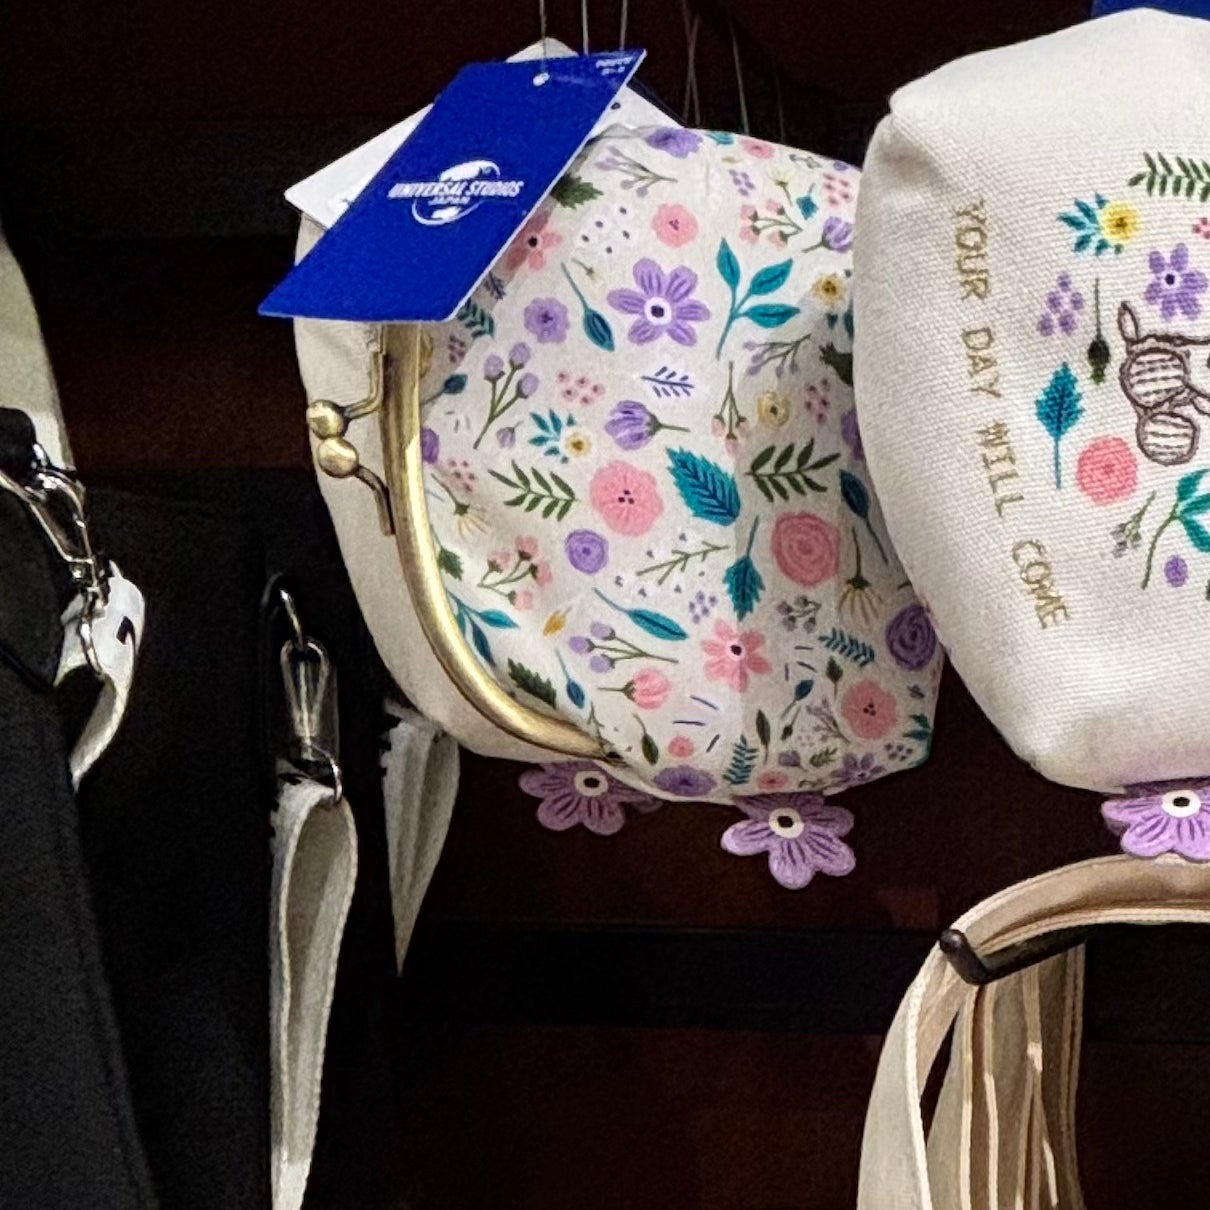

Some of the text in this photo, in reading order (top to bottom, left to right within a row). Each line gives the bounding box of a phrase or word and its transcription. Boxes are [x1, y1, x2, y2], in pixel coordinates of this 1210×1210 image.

[387, 181, 525, 198] UNIVERSAL STUDIOS
[954, 200, 1070, 630] YOUR DAY WILL COME
